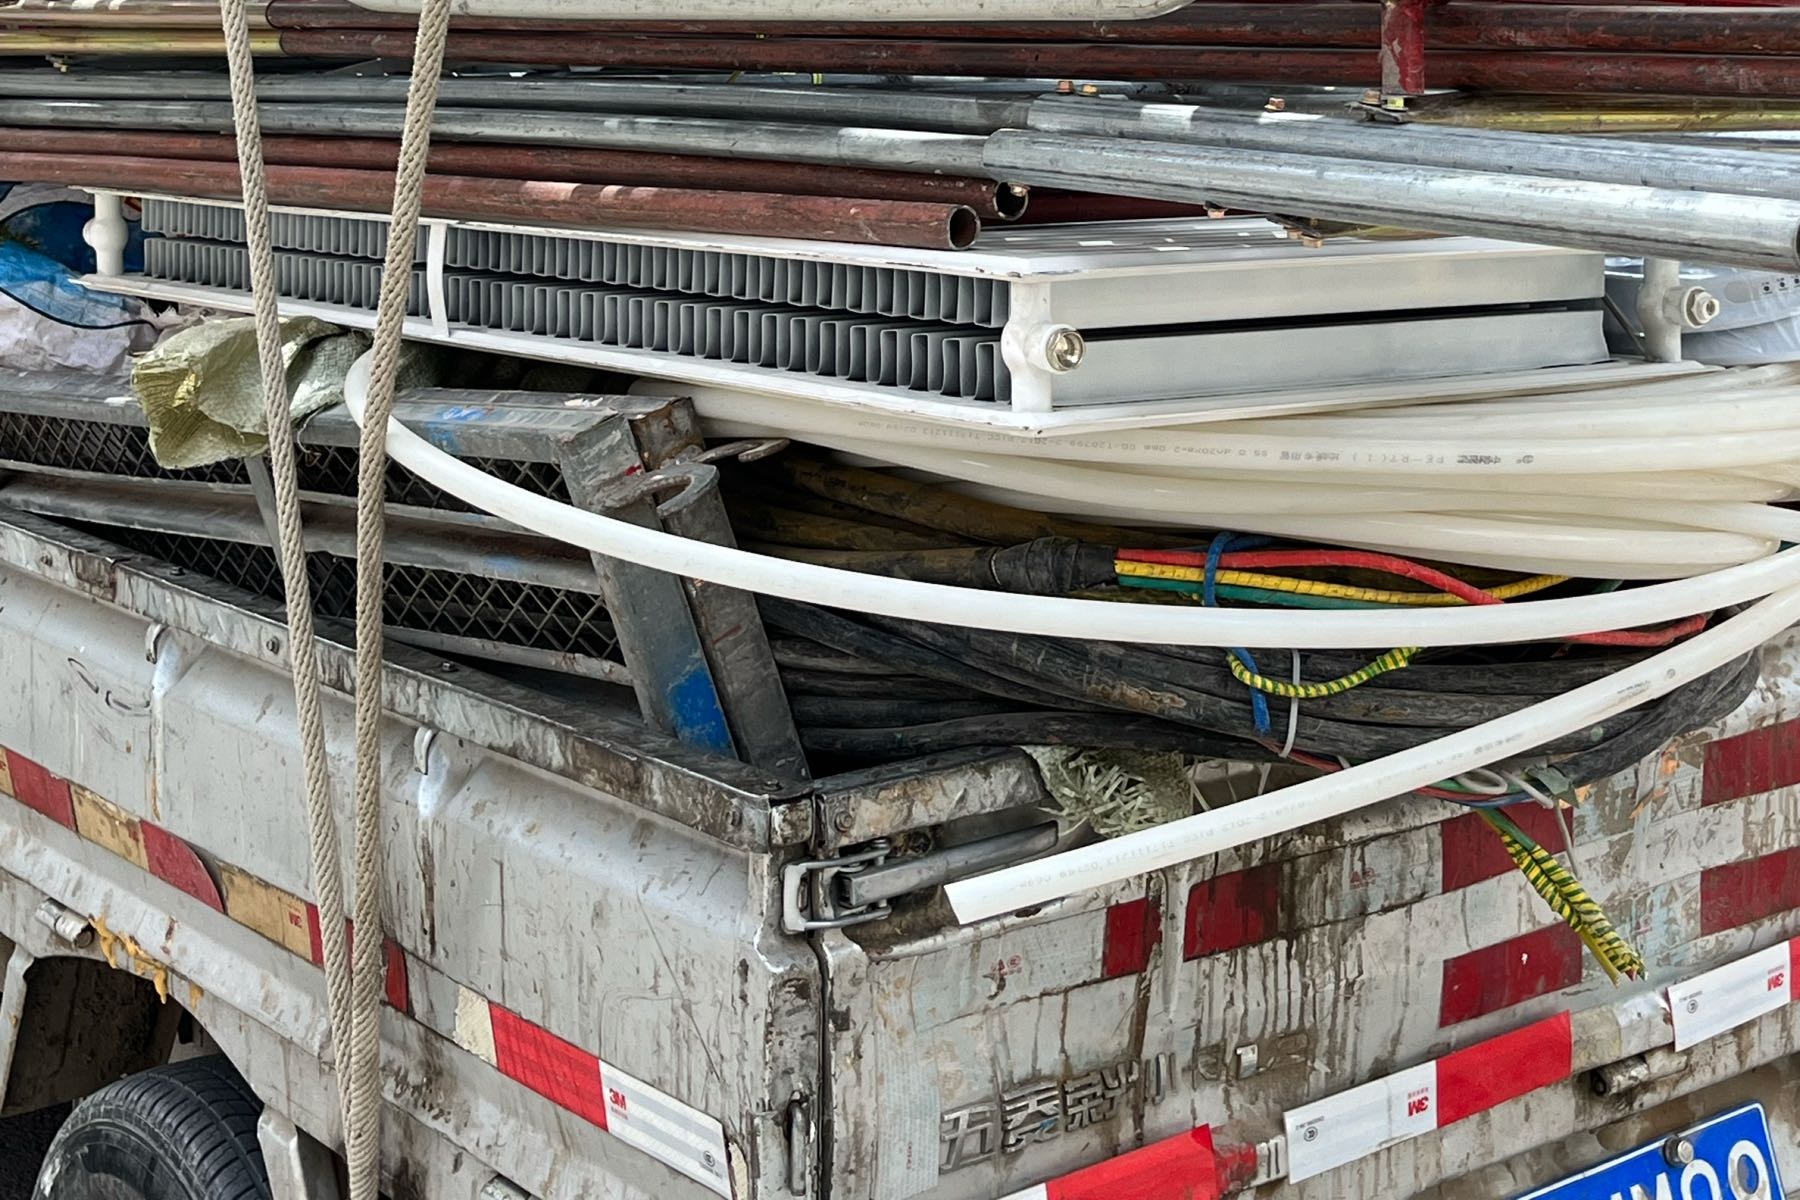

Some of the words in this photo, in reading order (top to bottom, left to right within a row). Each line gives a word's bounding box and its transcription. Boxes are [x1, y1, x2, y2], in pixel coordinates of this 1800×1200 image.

[1767, 973, 1784, 991] 3M
[609, 1088, 627, 1110] 3M
[1408, 1096, 1429, 1117] 3M
